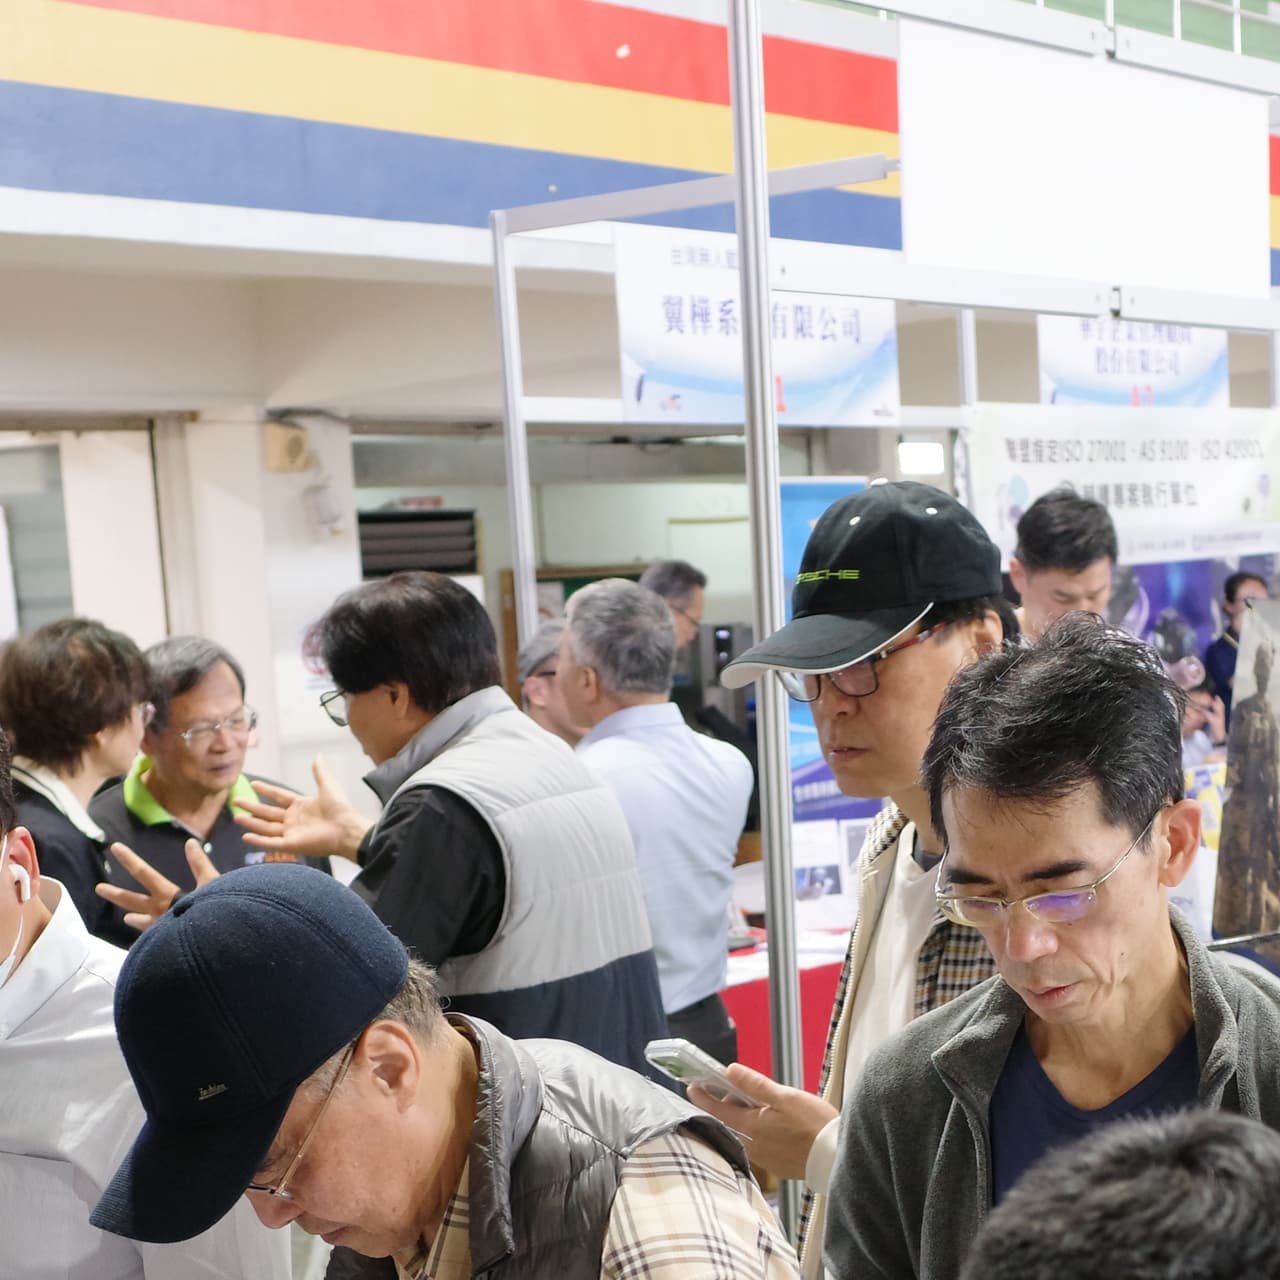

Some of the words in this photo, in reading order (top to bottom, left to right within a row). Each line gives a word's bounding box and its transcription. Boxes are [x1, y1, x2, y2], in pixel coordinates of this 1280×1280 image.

[662, 294, 863, 343] 翼樺系有限公司
